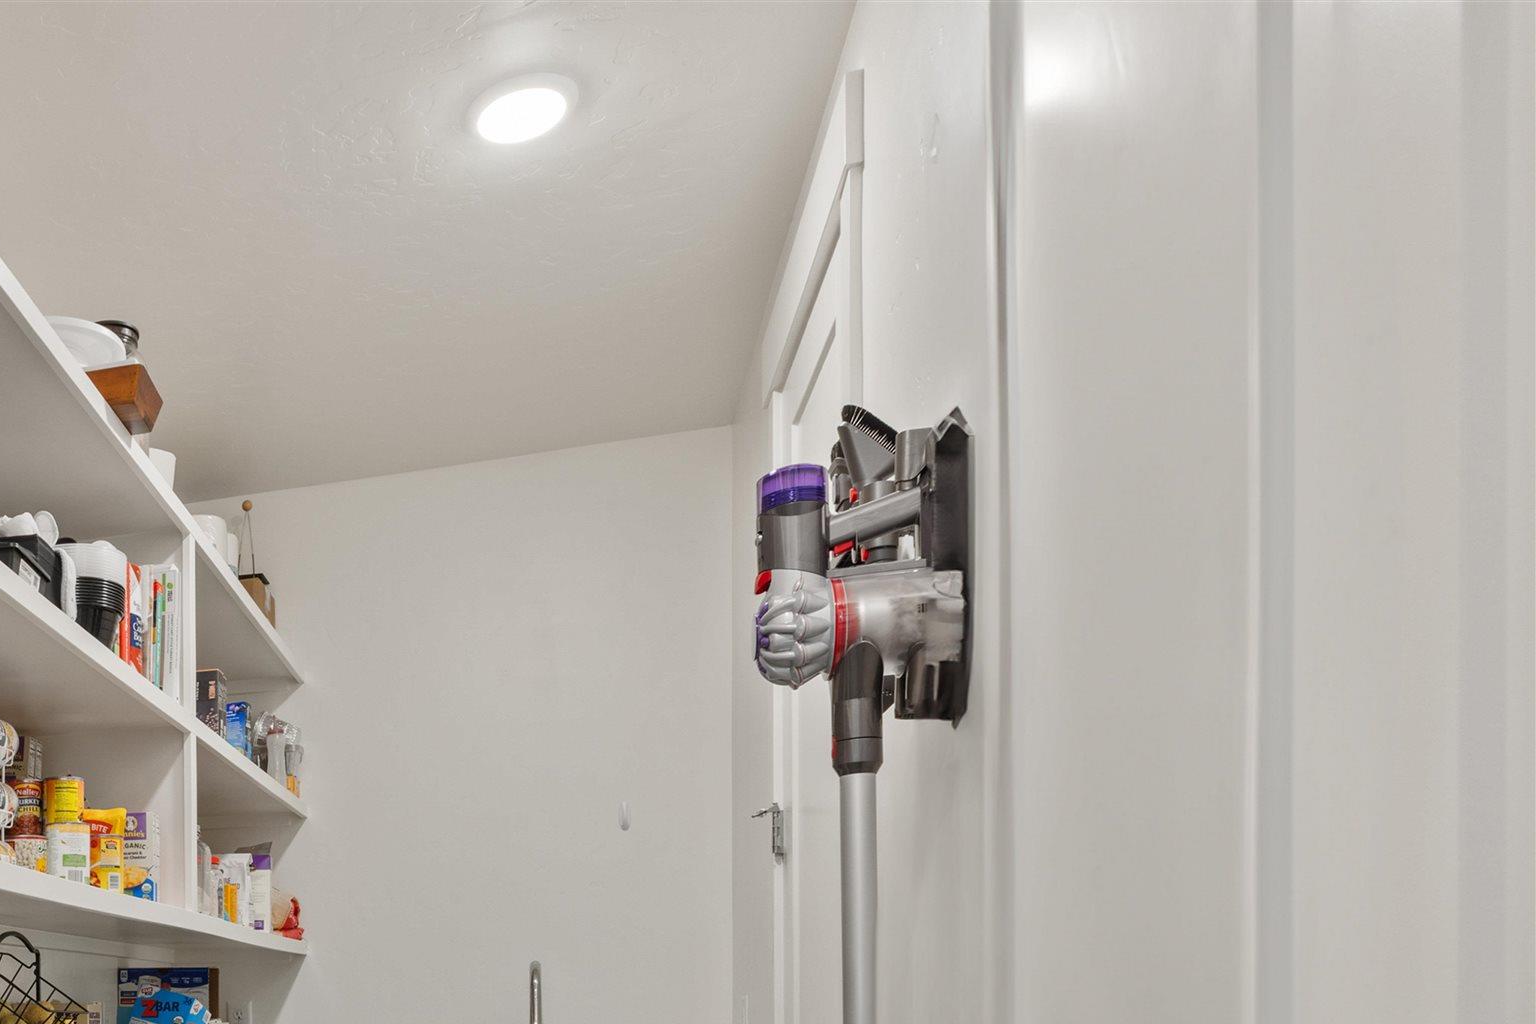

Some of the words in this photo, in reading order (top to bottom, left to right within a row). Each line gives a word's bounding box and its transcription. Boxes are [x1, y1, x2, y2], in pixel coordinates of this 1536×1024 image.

[17, 797, 41, 806] URKEY
[91, 823, 110, 835] BITE
[123, 830, 146, 839] nnie's
[124, 842, 147, 851] GANIC
